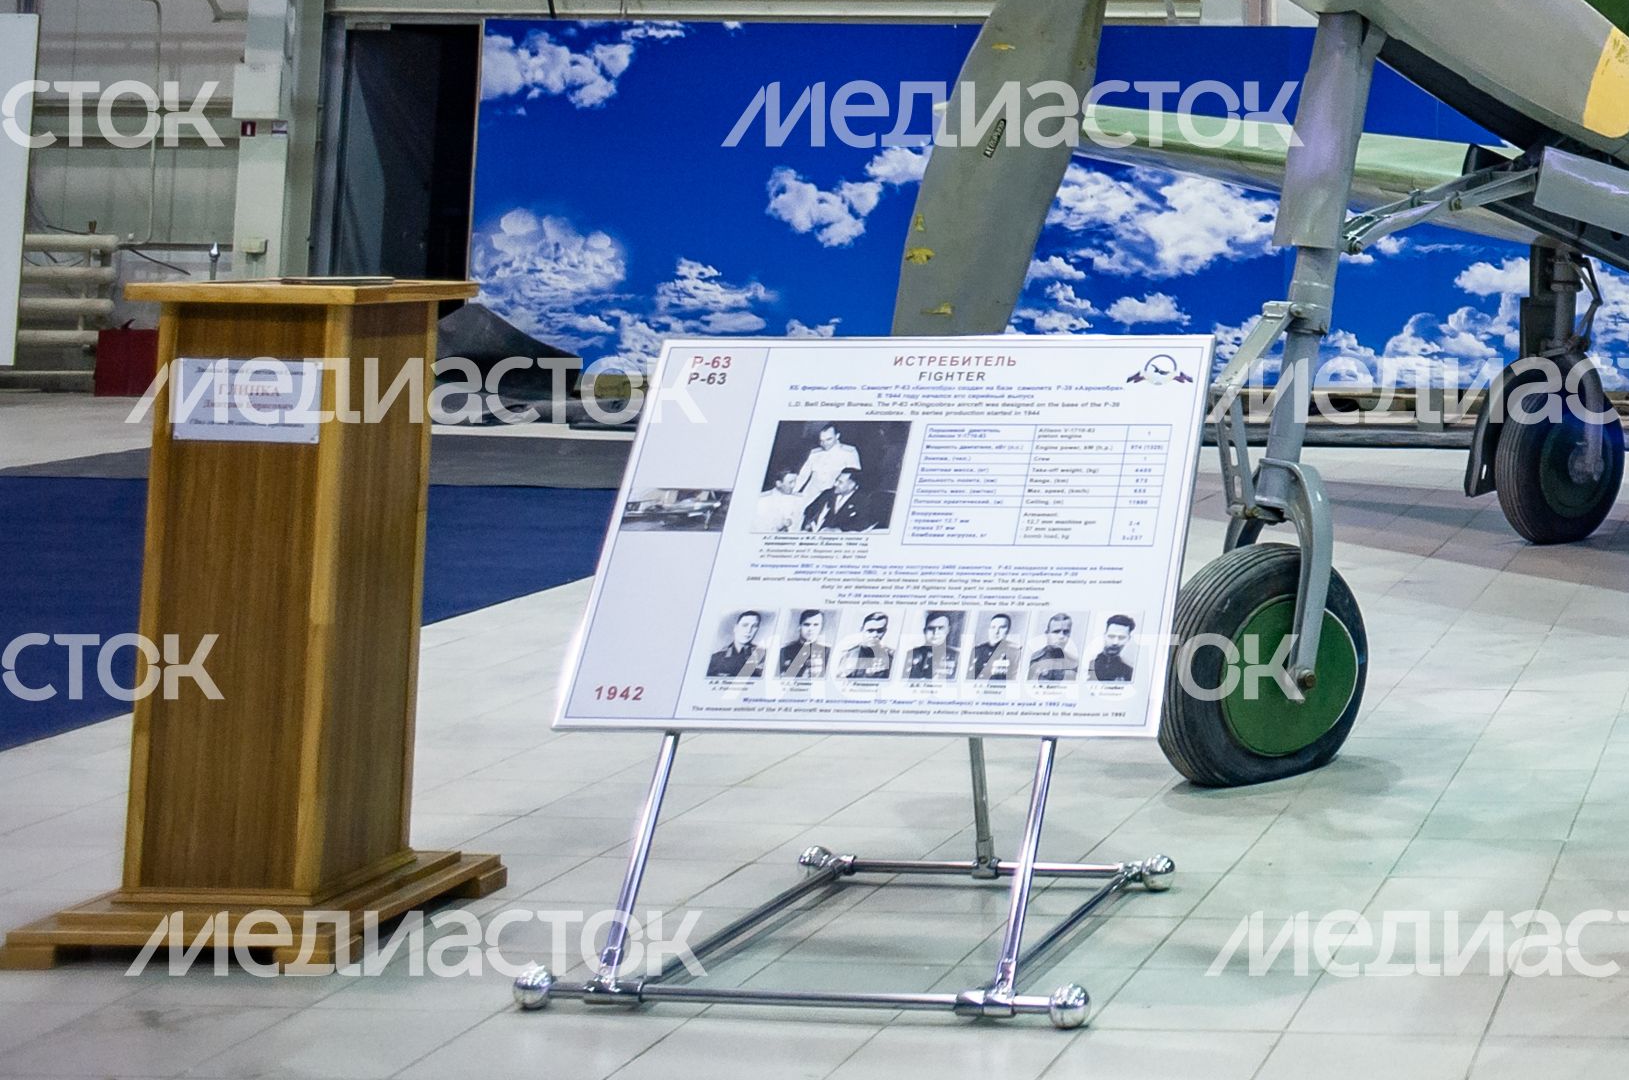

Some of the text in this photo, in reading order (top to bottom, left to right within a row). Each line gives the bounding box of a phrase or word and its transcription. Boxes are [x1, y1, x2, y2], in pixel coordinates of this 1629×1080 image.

[893, 355, 1017, 367] ИСТРЕБИТЕЛЬ
[687, 372, 727, 386] P-63
[918, 371, 986, 382] FIGHTER
[594, 685, 645, 701] 1942
